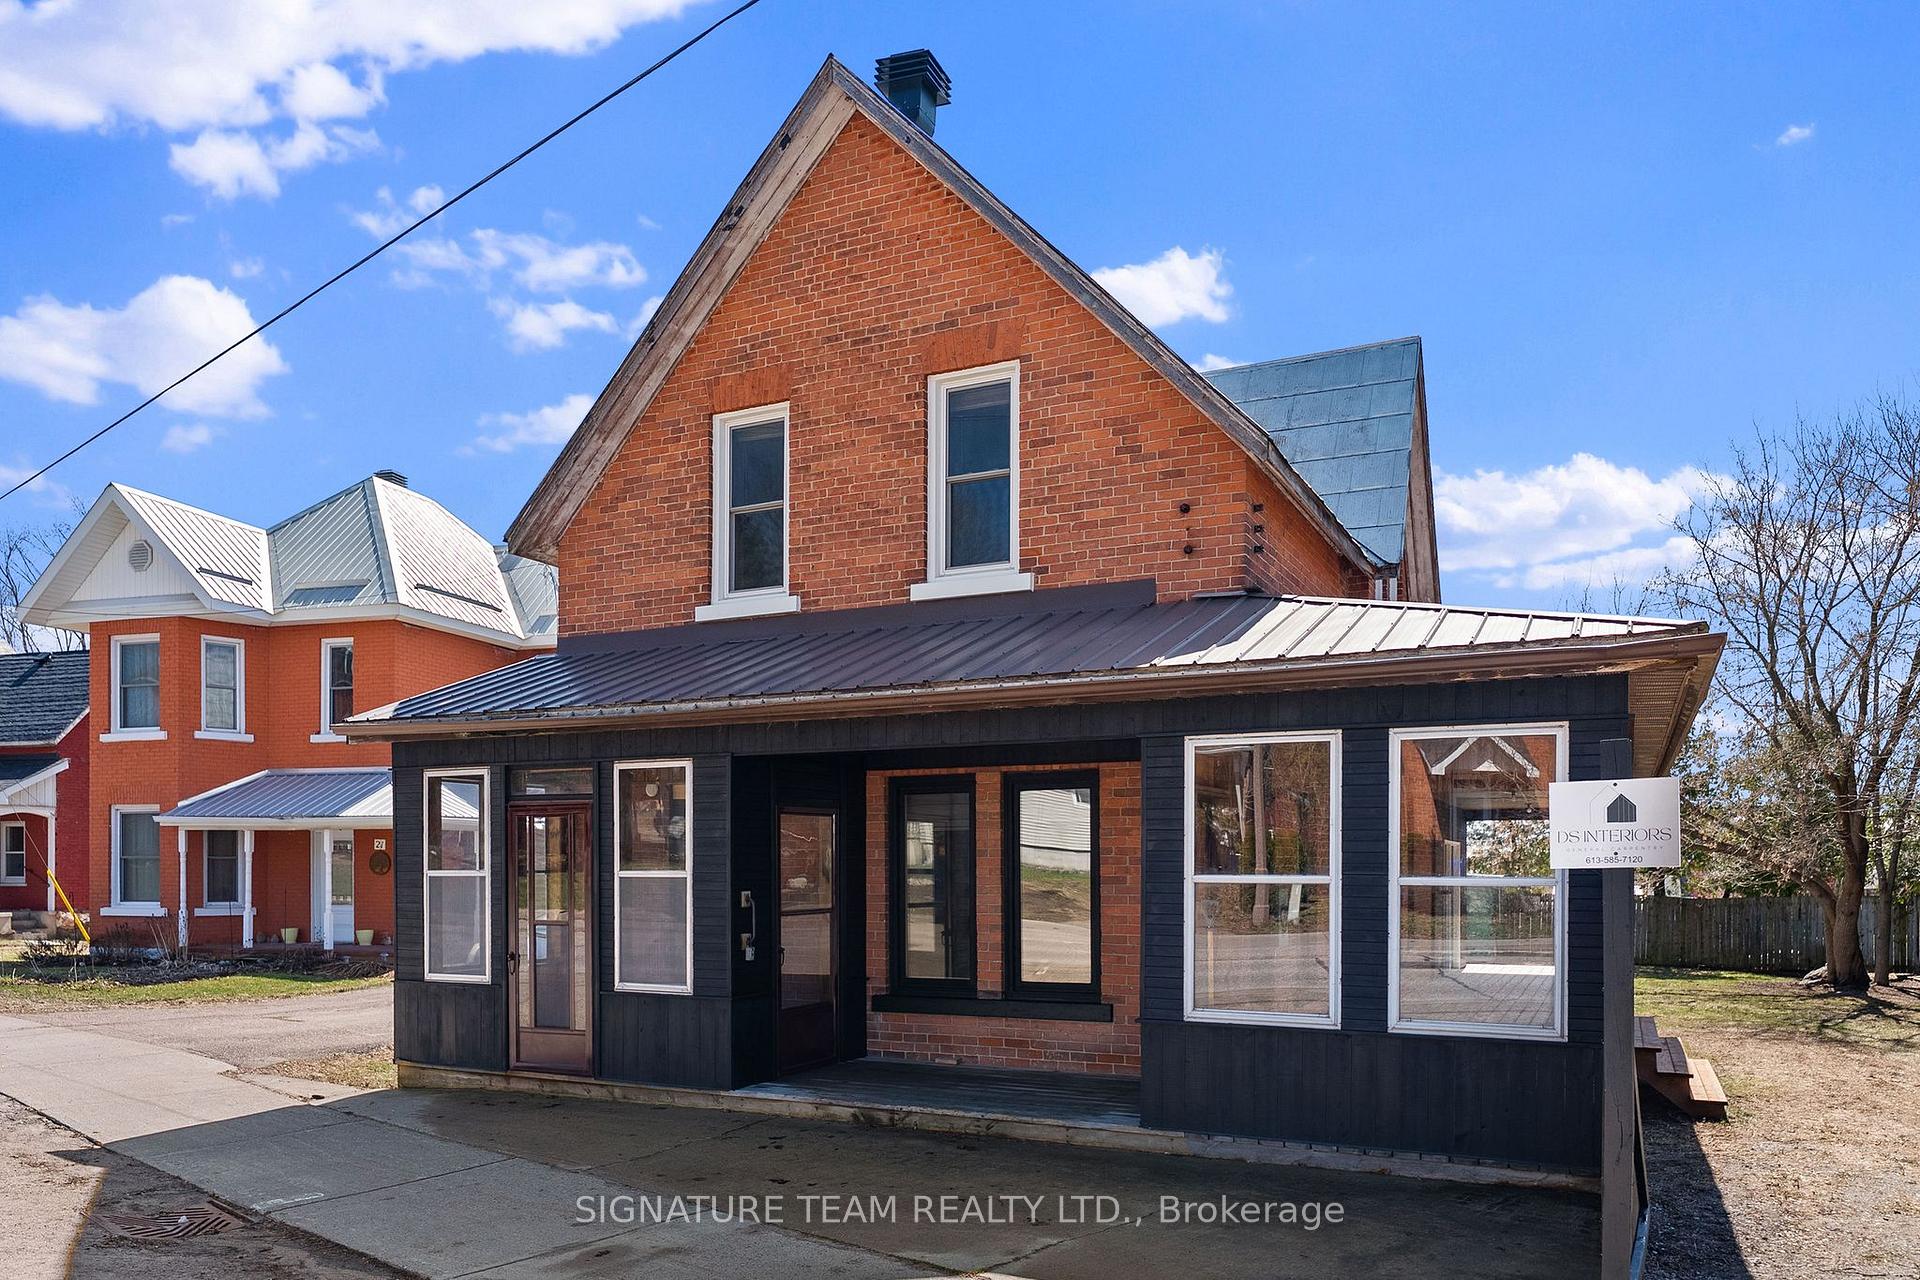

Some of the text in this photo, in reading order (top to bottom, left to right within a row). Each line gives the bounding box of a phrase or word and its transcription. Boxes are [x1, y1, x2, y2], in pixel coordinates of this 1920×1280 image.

[1557, 827, 1673, 844] DS INTERIORS
[1585, 855, 1643, 865] 613-585-7120
